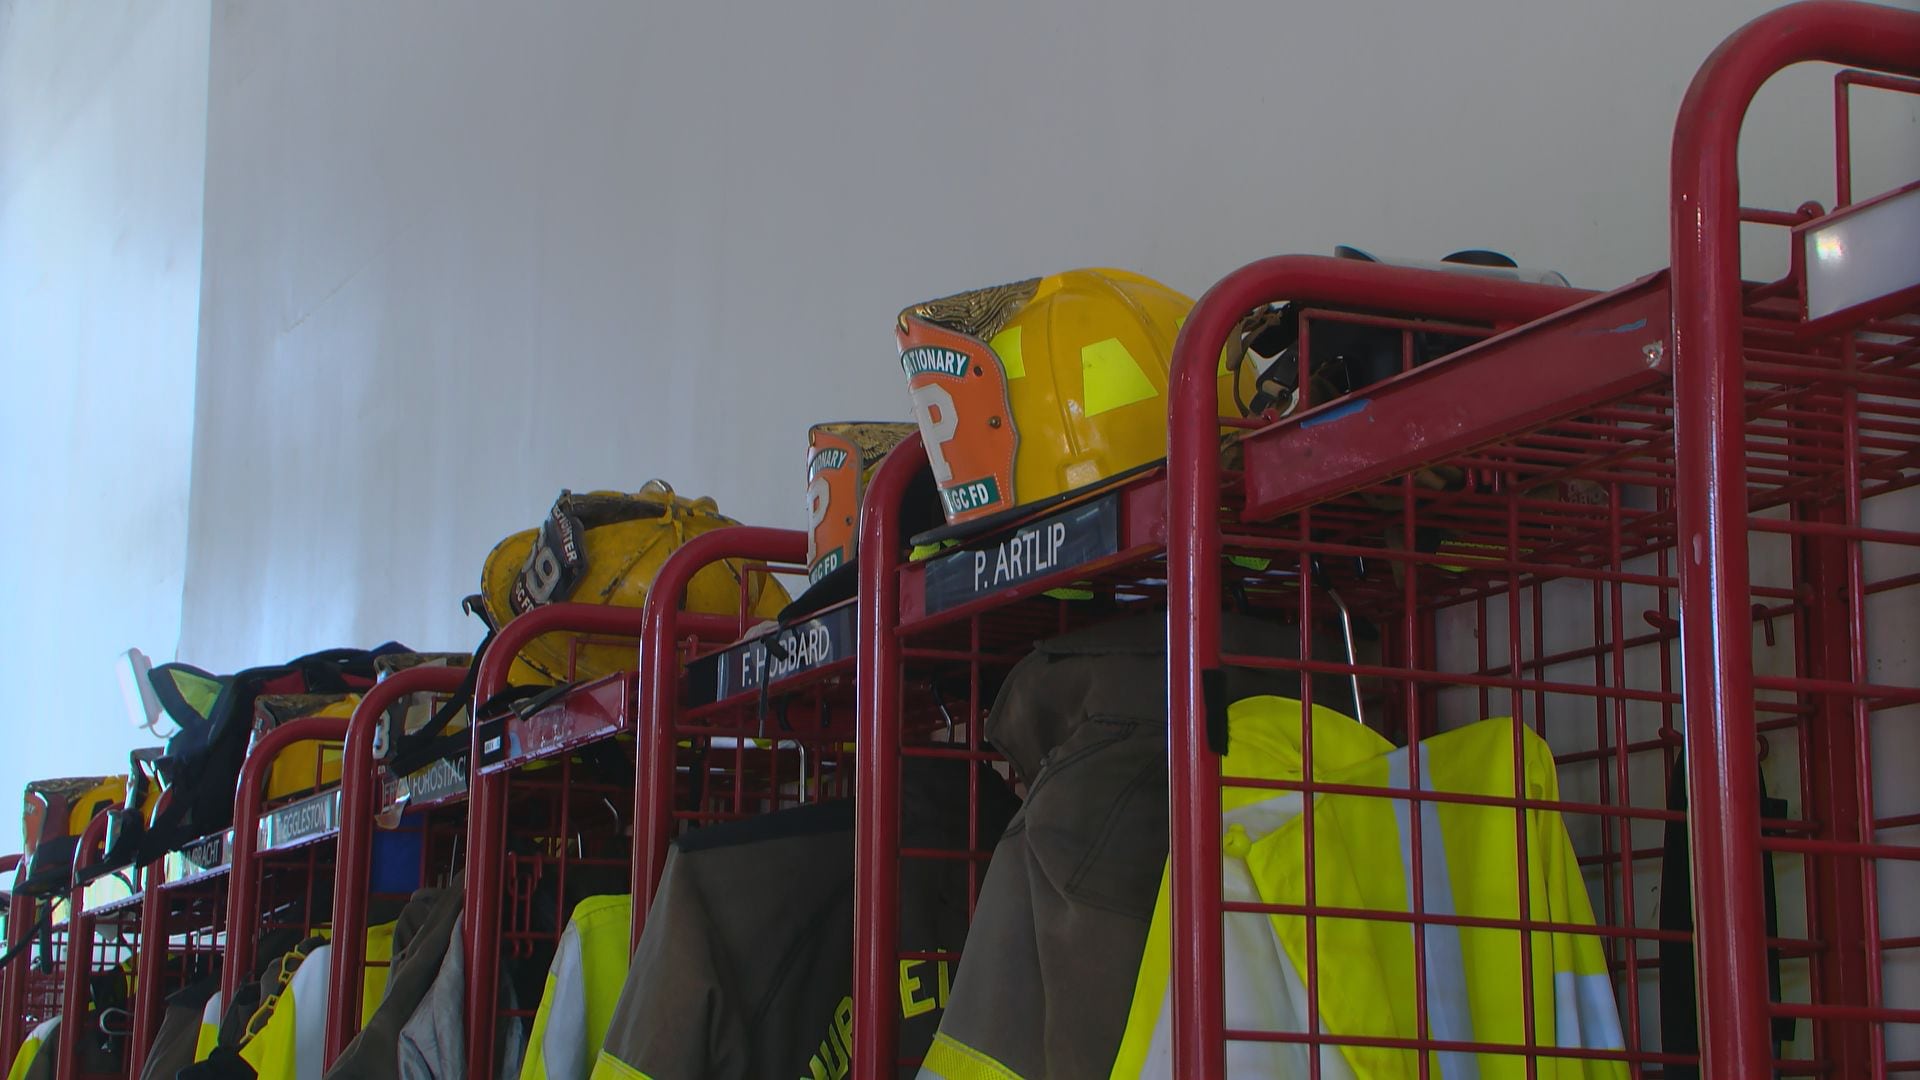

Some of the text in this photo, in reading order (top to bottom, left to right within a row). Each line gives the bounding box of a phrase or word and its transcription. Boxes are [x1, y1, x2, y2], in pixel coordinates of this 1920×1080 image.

[911, 383, 960, 485] P
[968, 483, 989, 507] FD
[974, 521, 1067, 592] P. ARTLIP
[742, 651, 753, 688] F.
